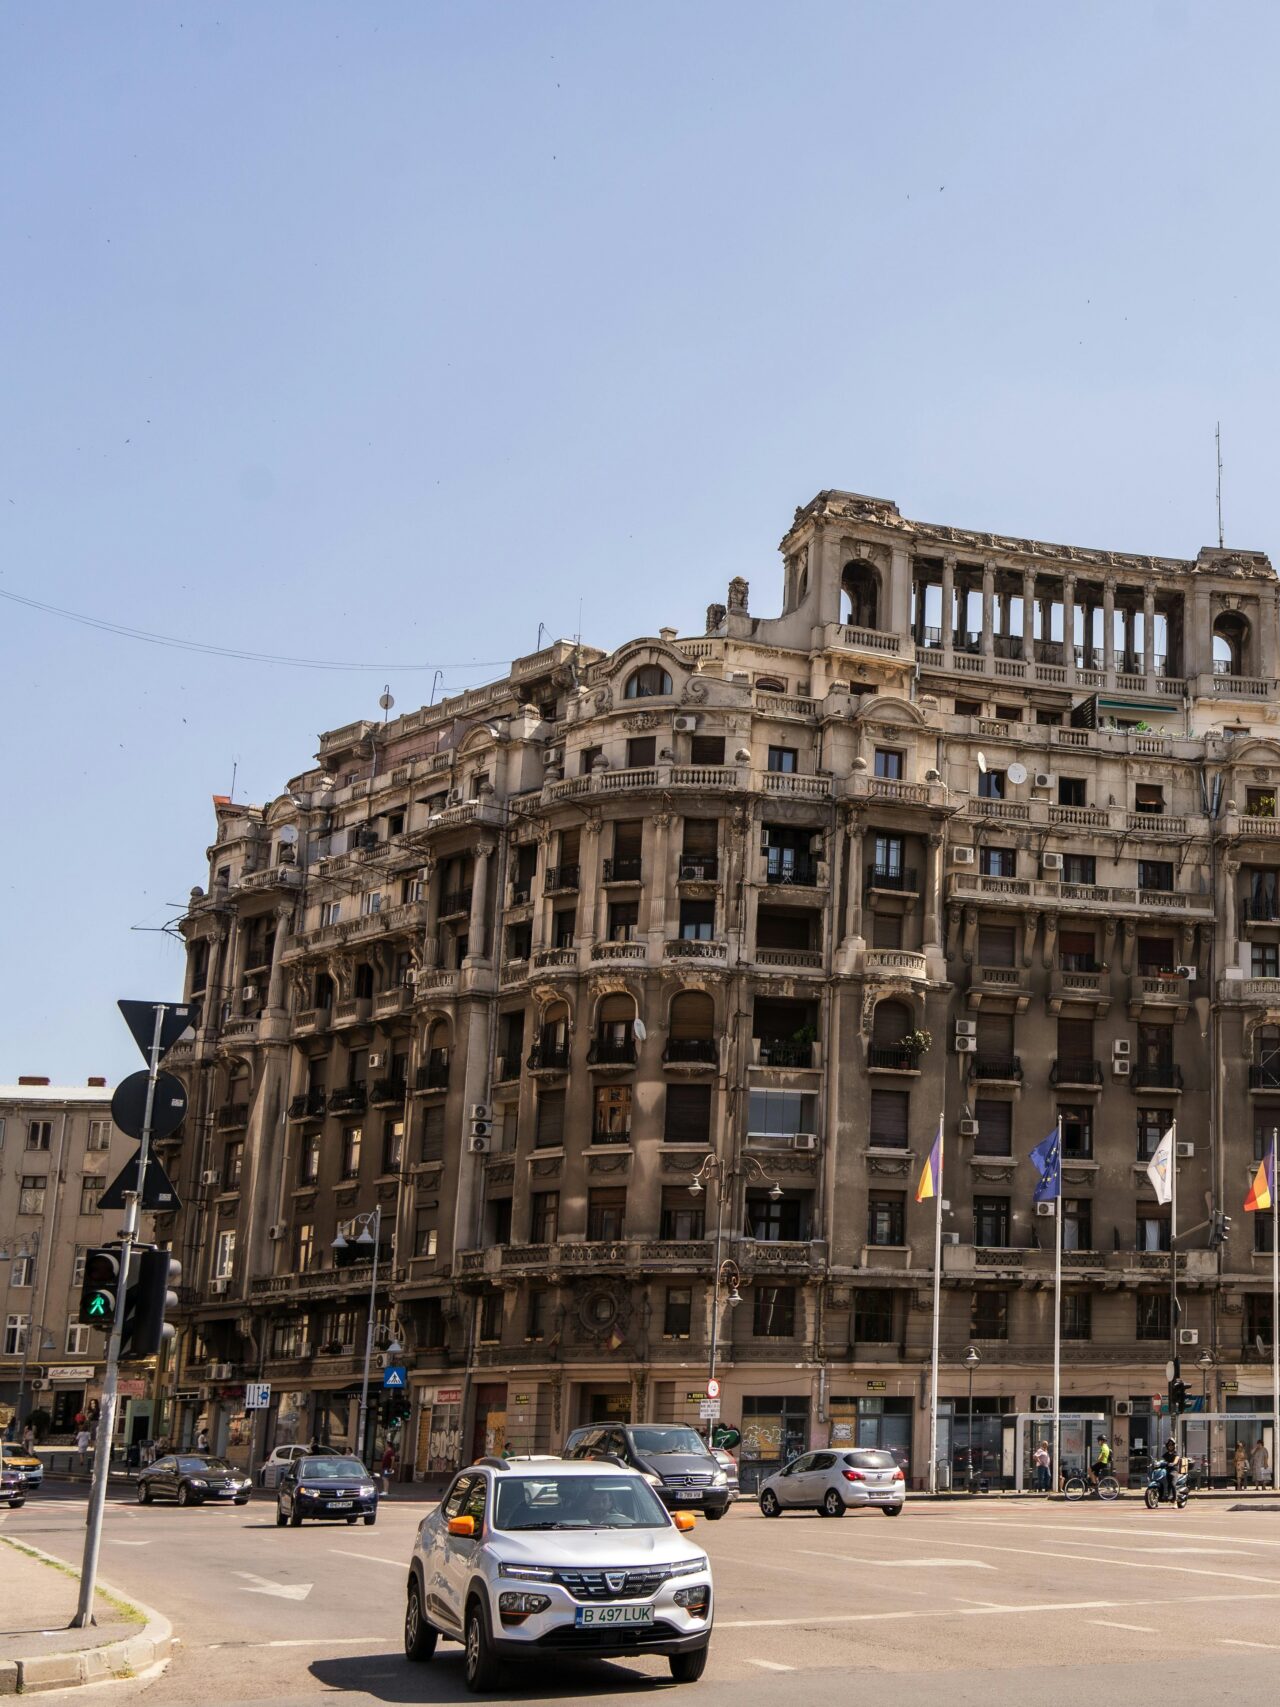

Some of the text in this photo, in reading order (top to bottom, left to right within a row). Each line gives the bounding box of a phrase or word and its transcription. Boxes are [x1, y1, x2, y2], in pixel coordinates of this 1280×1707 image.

[584, 1609, 594, 1622] B
[598, 1608, 622, 1622] 497
[624, 1607, 651, 1621] LUK
